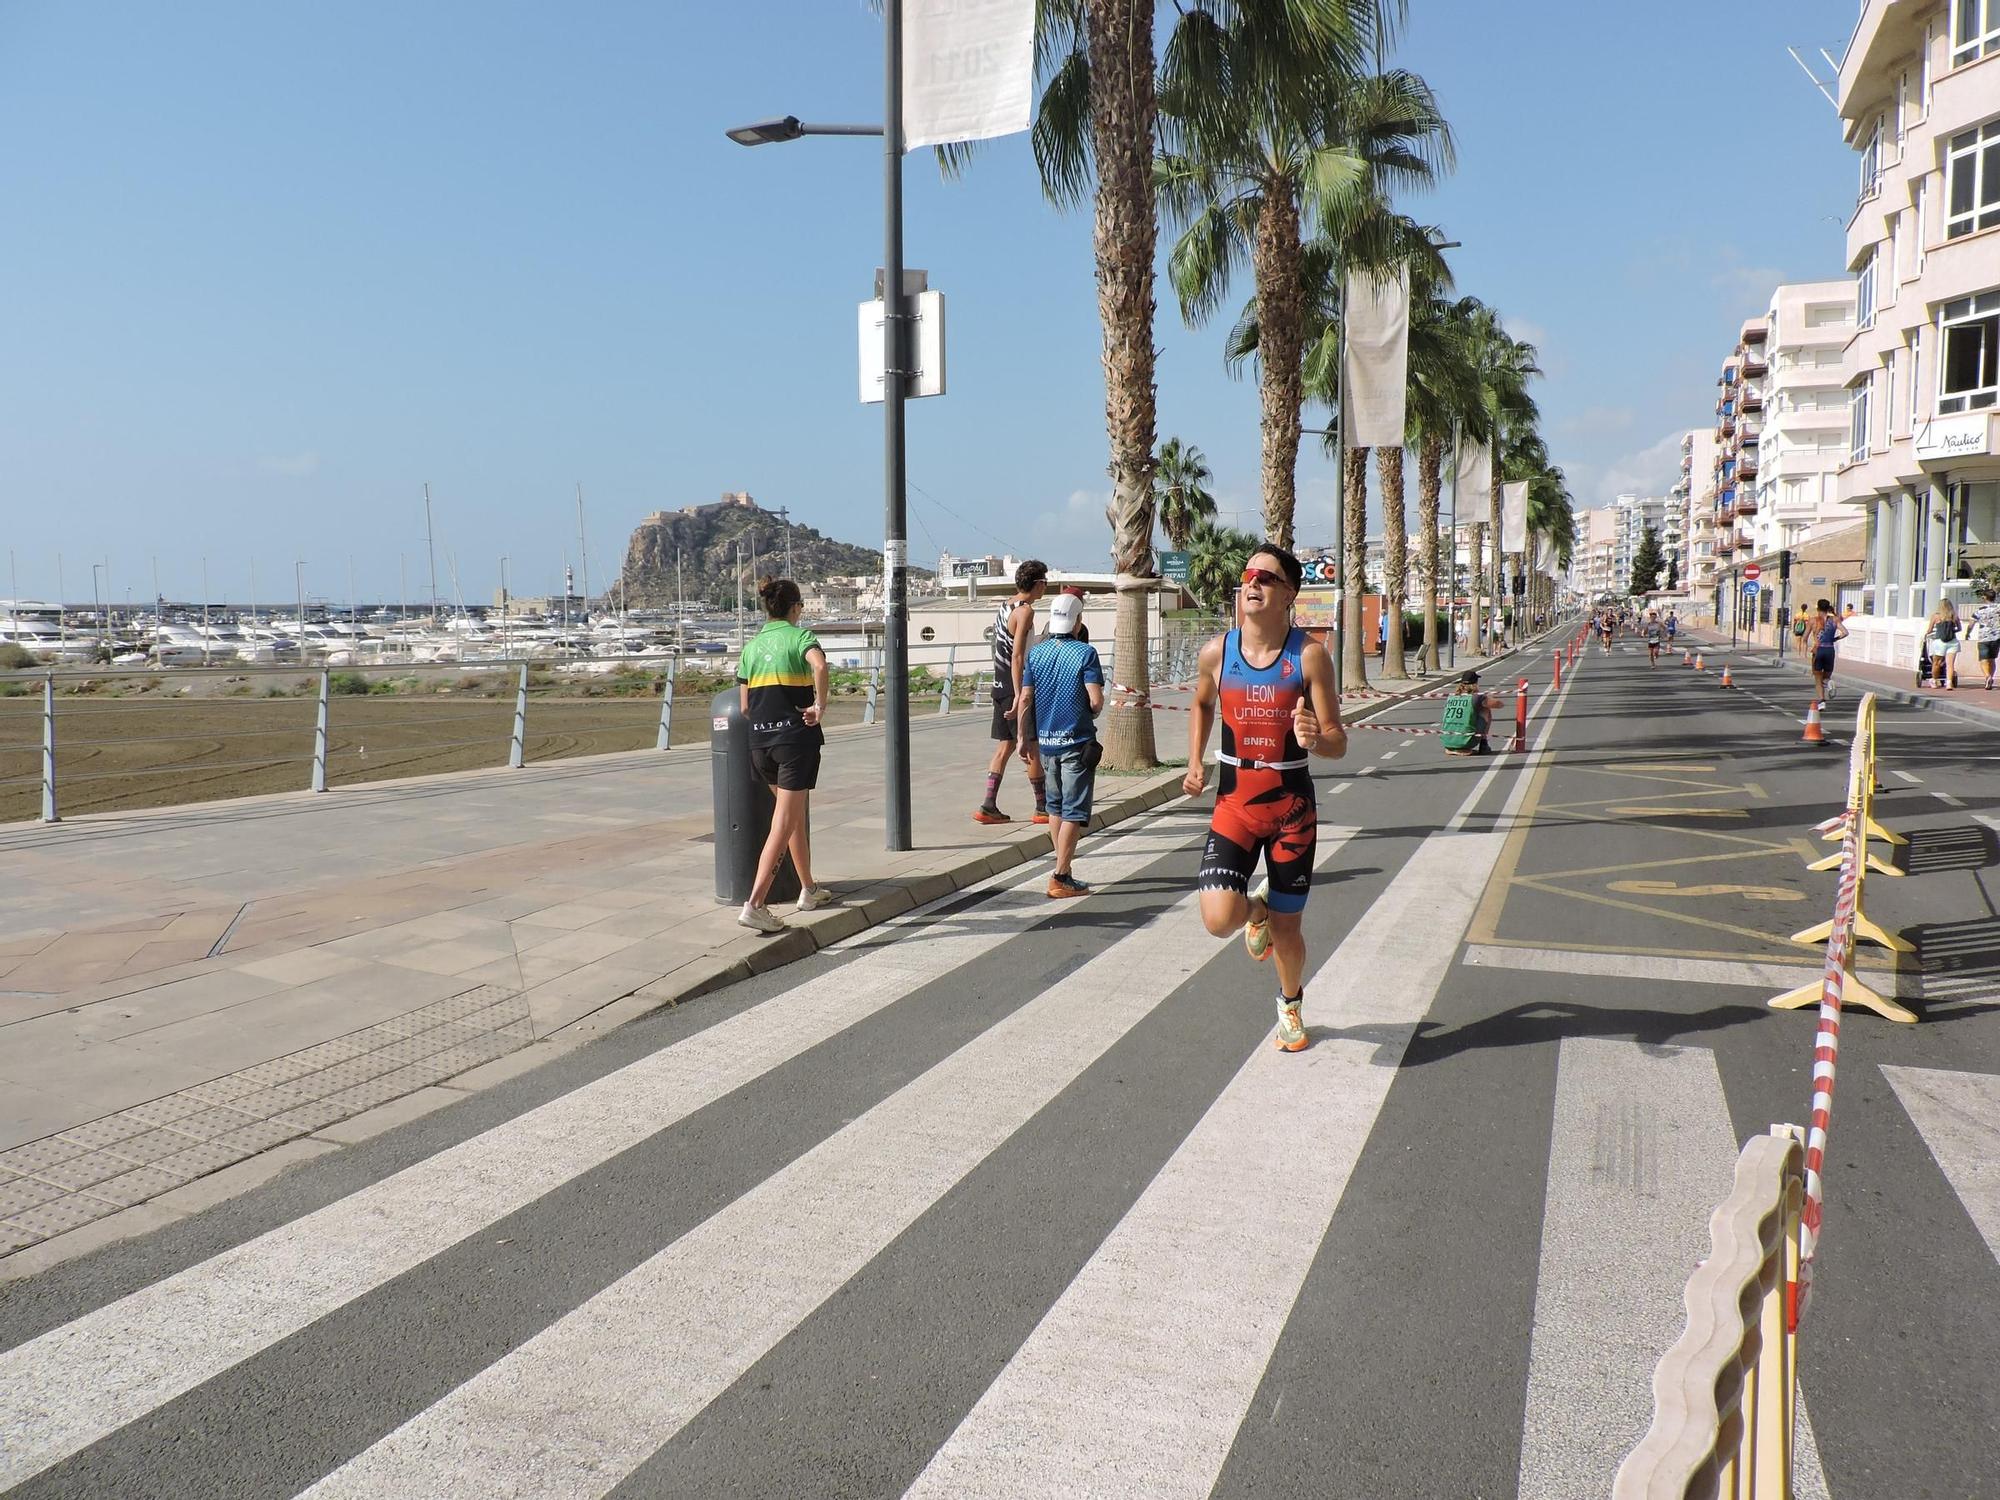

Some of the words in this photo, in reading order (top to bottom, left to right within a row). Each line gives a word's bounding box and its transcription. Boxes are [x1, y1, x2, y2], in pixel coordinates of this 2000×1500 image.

[1246, 683, 1275, 703] LEON
[1446, 707, 1464, 719] 279
[753, 720, 791, 731] KATOA
[1243, 737, 1276, 748] BNFIX
